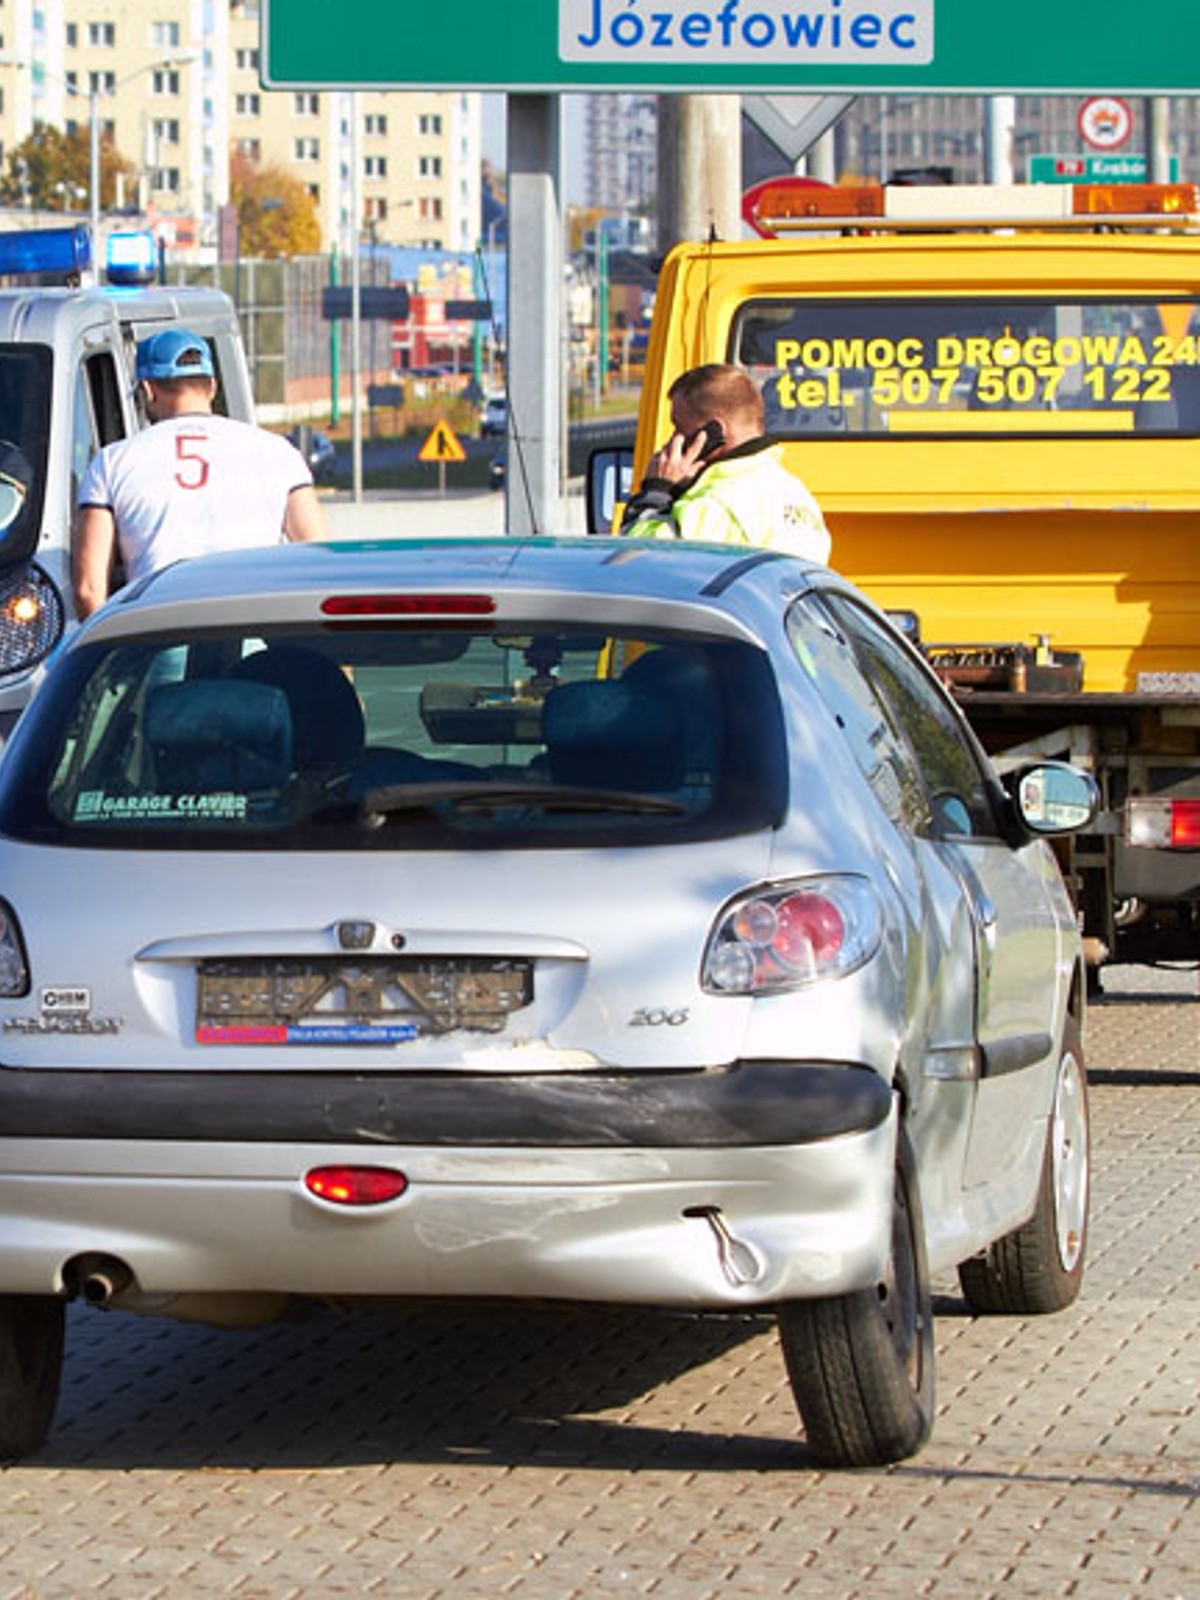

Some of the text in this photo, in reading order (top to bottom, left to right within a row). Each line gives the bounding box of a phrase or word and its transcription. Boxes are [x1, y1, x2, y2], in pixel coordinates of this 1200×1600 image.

[578, 0, 916, 48] Józefowiec
[775, 334, 1200, 369] POMOC DROGOWA 24
[775, 365, 1171, 410] tel. 507 507 122
[174, 434, 210, 490] 5
[102, 795, 173, 811] GARAGE
[628, 1007, 690, 1027] 206
